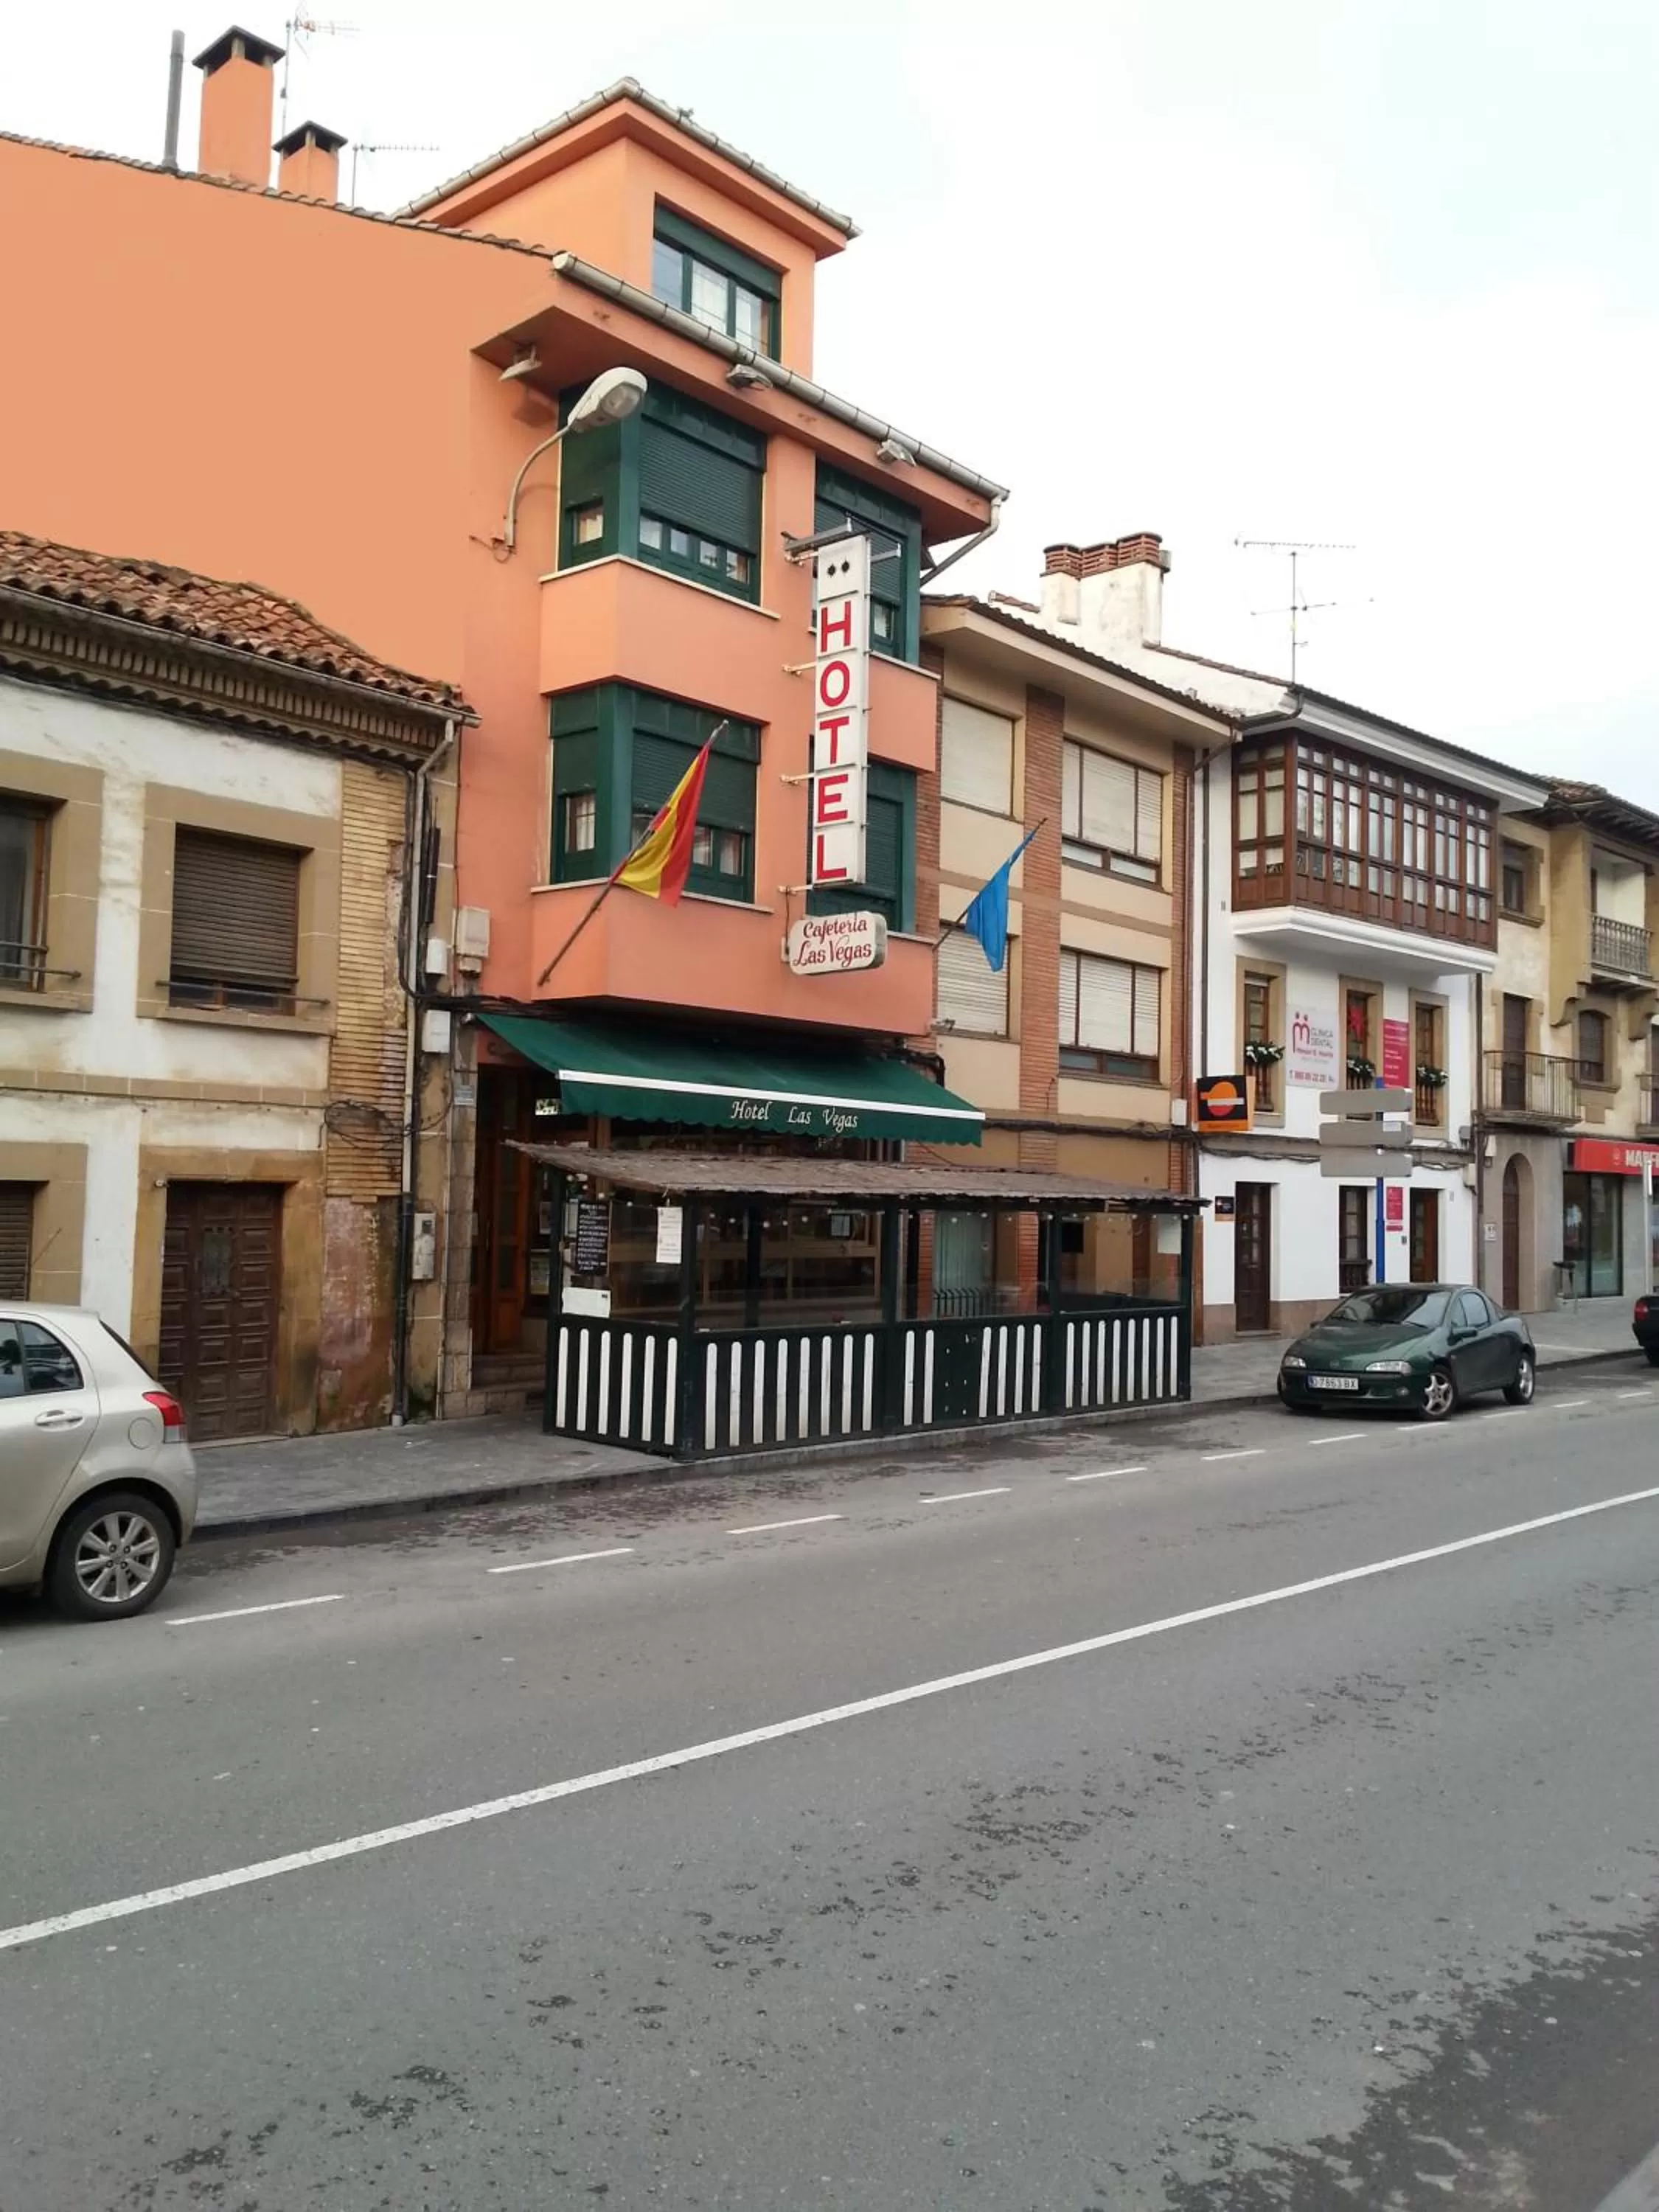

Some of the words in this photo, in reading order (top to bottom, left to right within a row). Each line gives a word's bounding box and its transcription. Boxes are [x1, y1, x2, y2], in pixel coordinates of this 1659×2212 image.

[815, 600, 852, 880] HOTEL
[793, 940, 827, 967] Las
[829, 934, 872, 968] Vegas
[731, 1099, 773, 1121] Hotel
[787, 1106, 813, 1125] Las
[822, 1107, 859, 1133] Vegas
